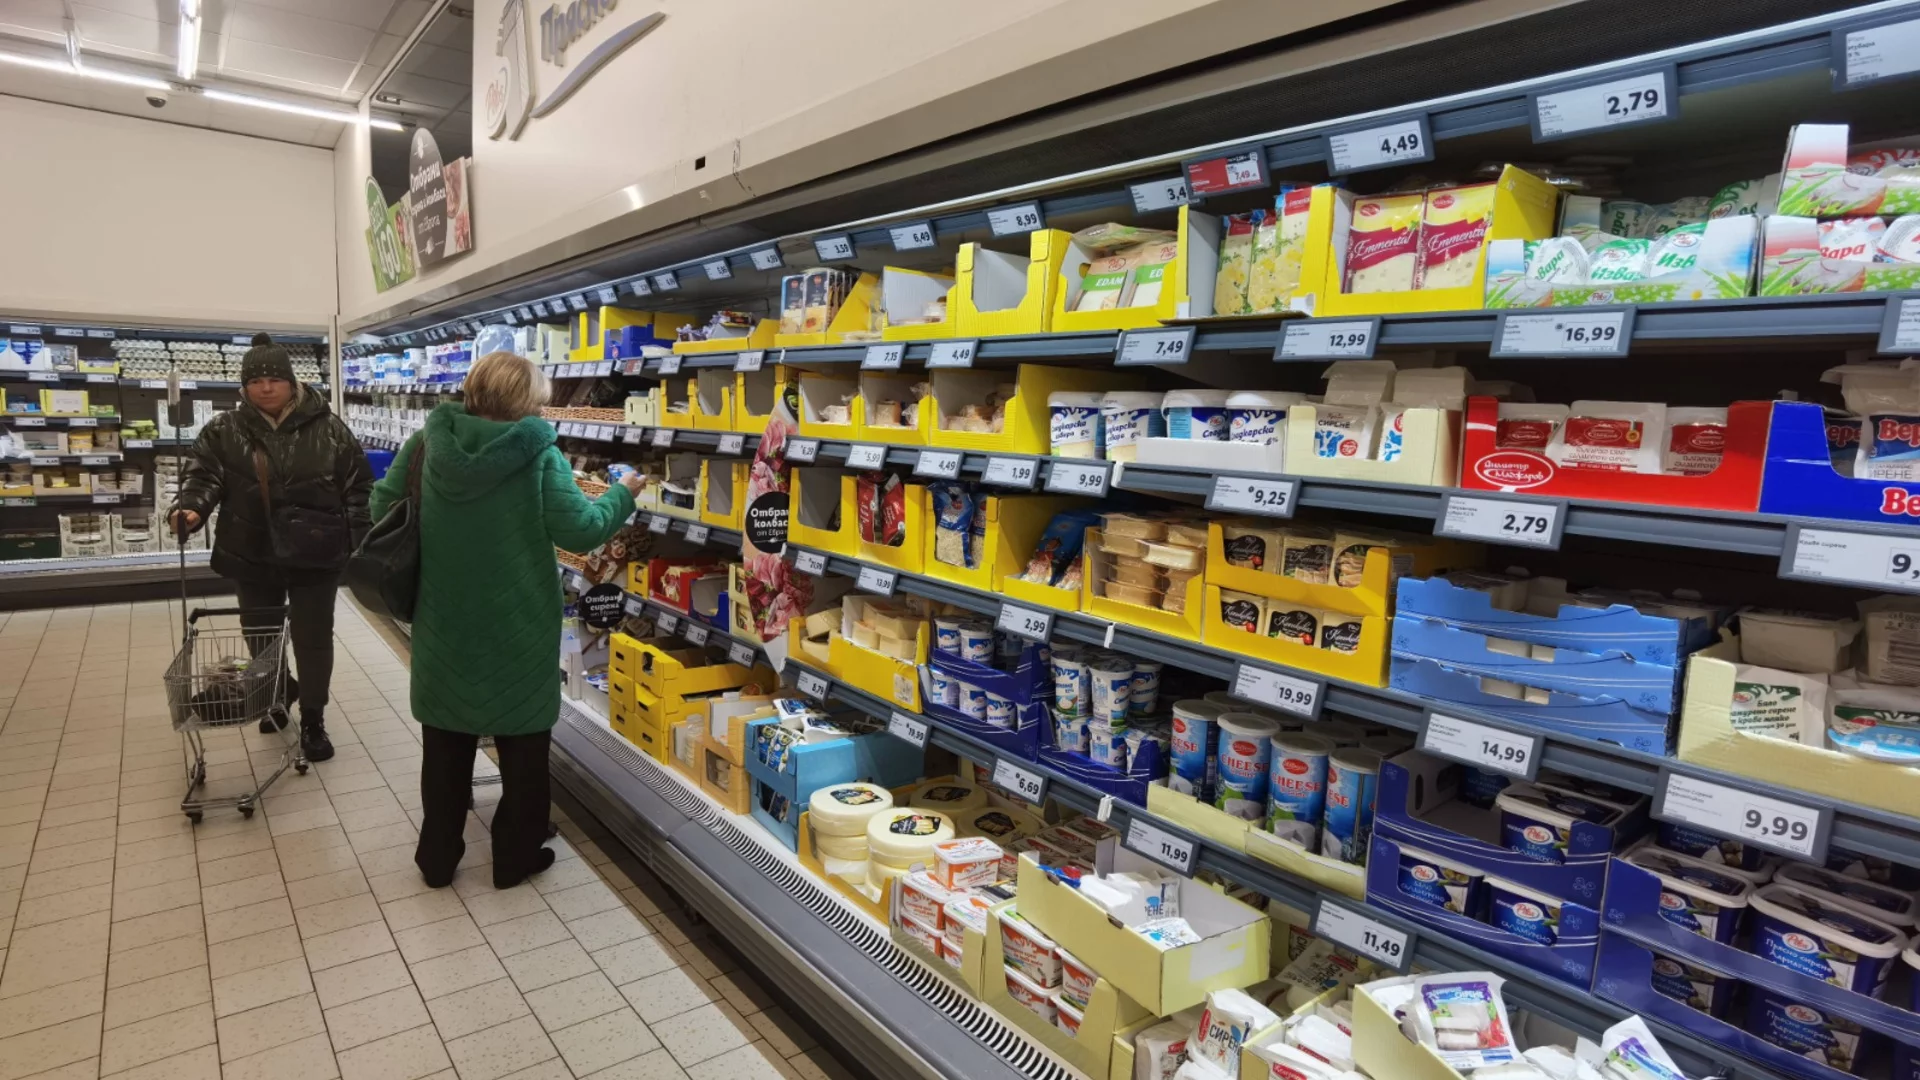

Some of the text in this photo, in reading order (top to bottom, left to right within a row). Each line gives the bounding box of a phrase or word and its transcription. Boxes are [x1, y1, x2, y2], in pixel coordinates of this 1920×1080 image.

[1607, 89, 1658, 116] 2,79
[1381, 133, 1418, 155] 4,49
[1016, 212, 1038, 227] 8,99
[913, 230, 930, 242] 6,49
[1355, 229, 1411, 259] Emmental
[1095, 272, 1123, 286] EDAM
[1330, 333, 1366, 349] 12,99
[1565, 326, 1616, 344] 16,99
[952, 348, 970, 360] 4,49
[1156, 340, 1184, 356] 7,49
[938, 460, 956, 472] 4,49
[1012, 467, 1030, 480] 1,99
[1079, 473, 1102, 488] 9,99
[1254, 489, 1287, 506] 9,25
[1503, 514, 1548, 534] 2,79
[1024, 618, 1046, 633] 2,99
[1279, 686, 1312, 706] 19,99
[1482, 740, 1526, 764] 14,99
[1221, 752, 1269, 773] CHEESE
[1018, 777, 1040, 795] 6,69
[1271, 771, 1321, 793] CHEESE
[1745, 809, 1809, 841] 9,99
[1161, 841, 1188, 863] 11,99
[1364, 931, 1400, 957] 11,49
